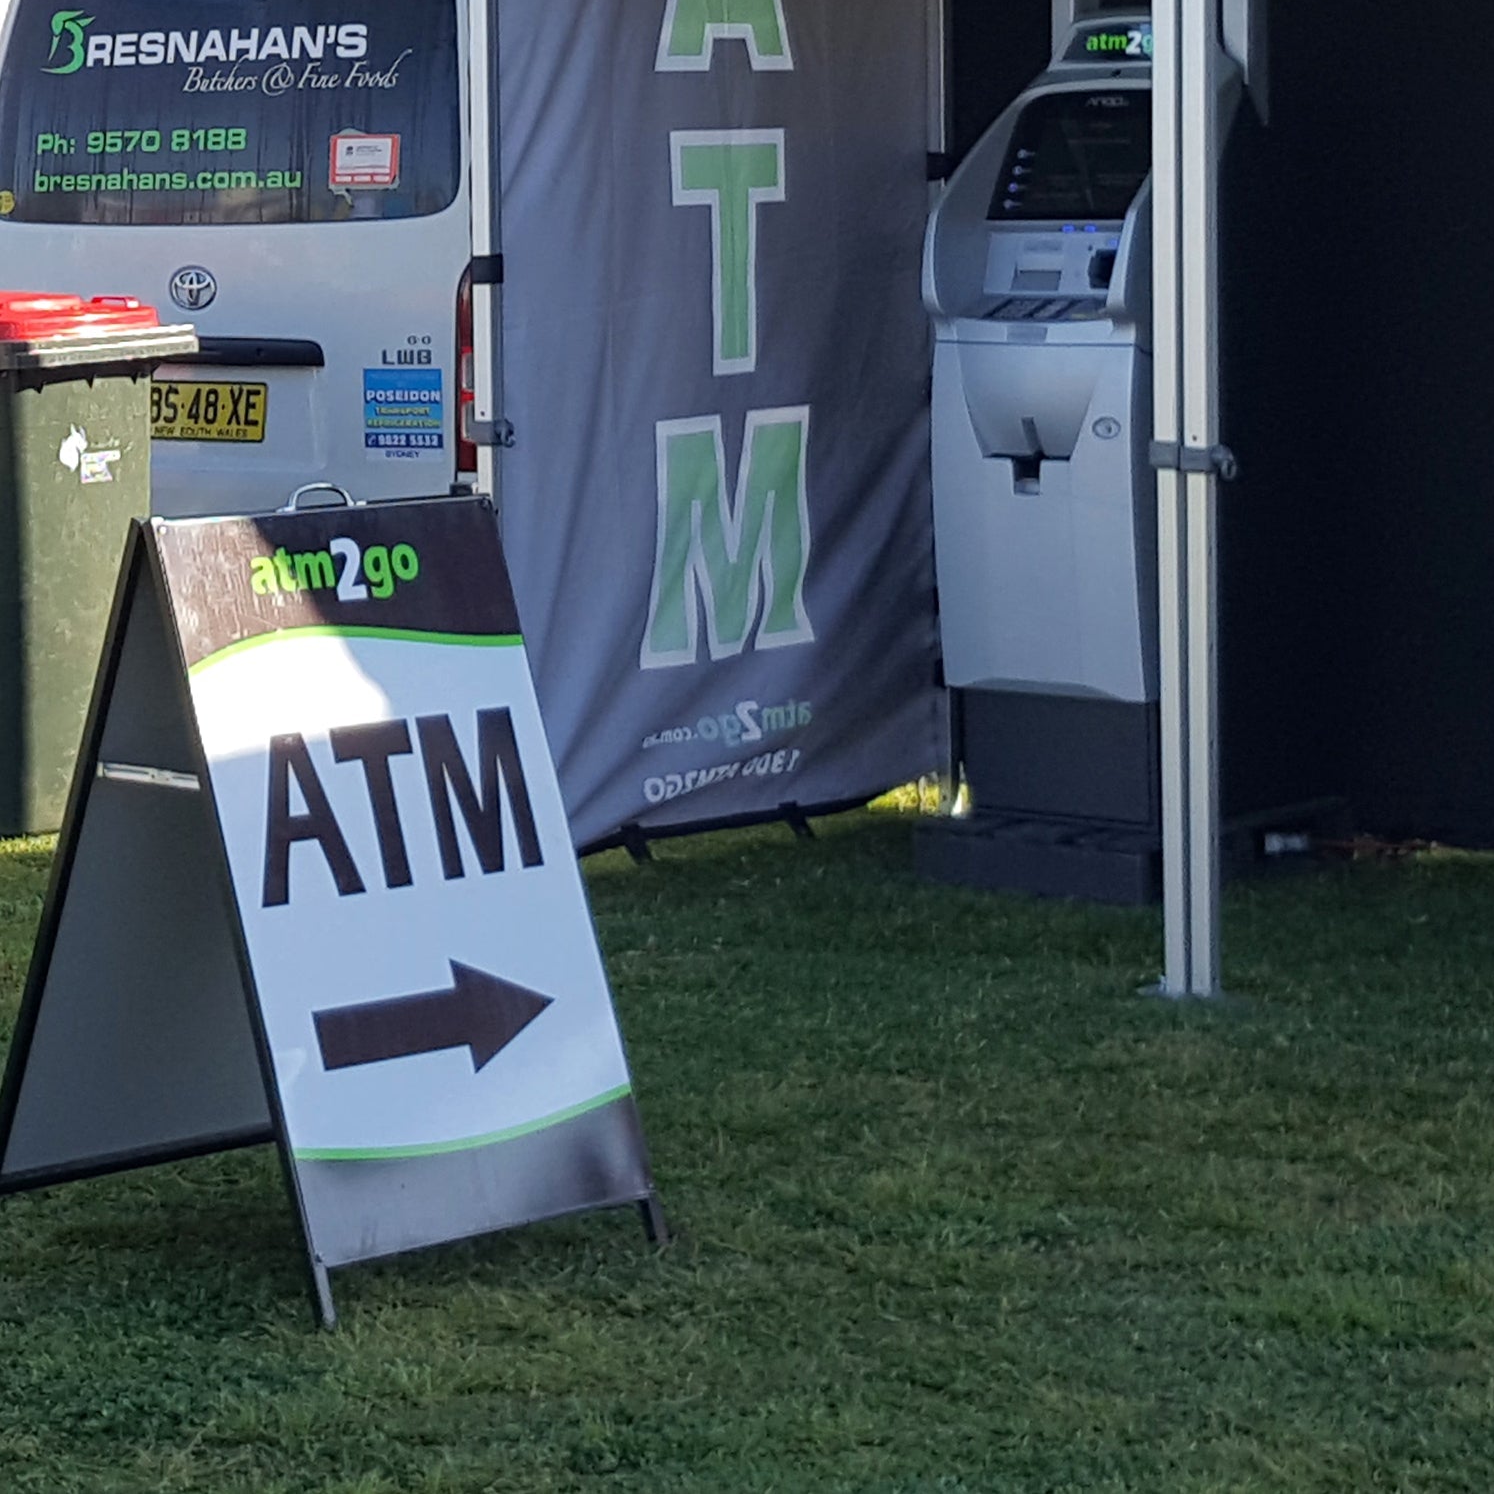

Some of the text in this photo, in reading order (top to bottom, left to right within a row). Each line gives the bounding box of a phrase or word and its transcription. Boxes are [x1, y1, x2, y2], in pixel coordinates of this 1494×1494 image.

[1086, 31, 1153, 55] atm2g
[183, 55, 258, 93] Butchers
[298, 61, 340, 89] Fine
[344, 48, 412, 88] Foods
[37, 128, 248, 154] Ph: 9570 8188
[34, 169, 302, 192] bresnahans.com.au
[382, 349, 432, 365] LWB
[366, 389, 440, 403] POSEIDON
[154, 426, 248, 438] NEW SOUTH WALES
[250, 538, 419, 602] atm2go
[261, 706, 545, 908] ATM
